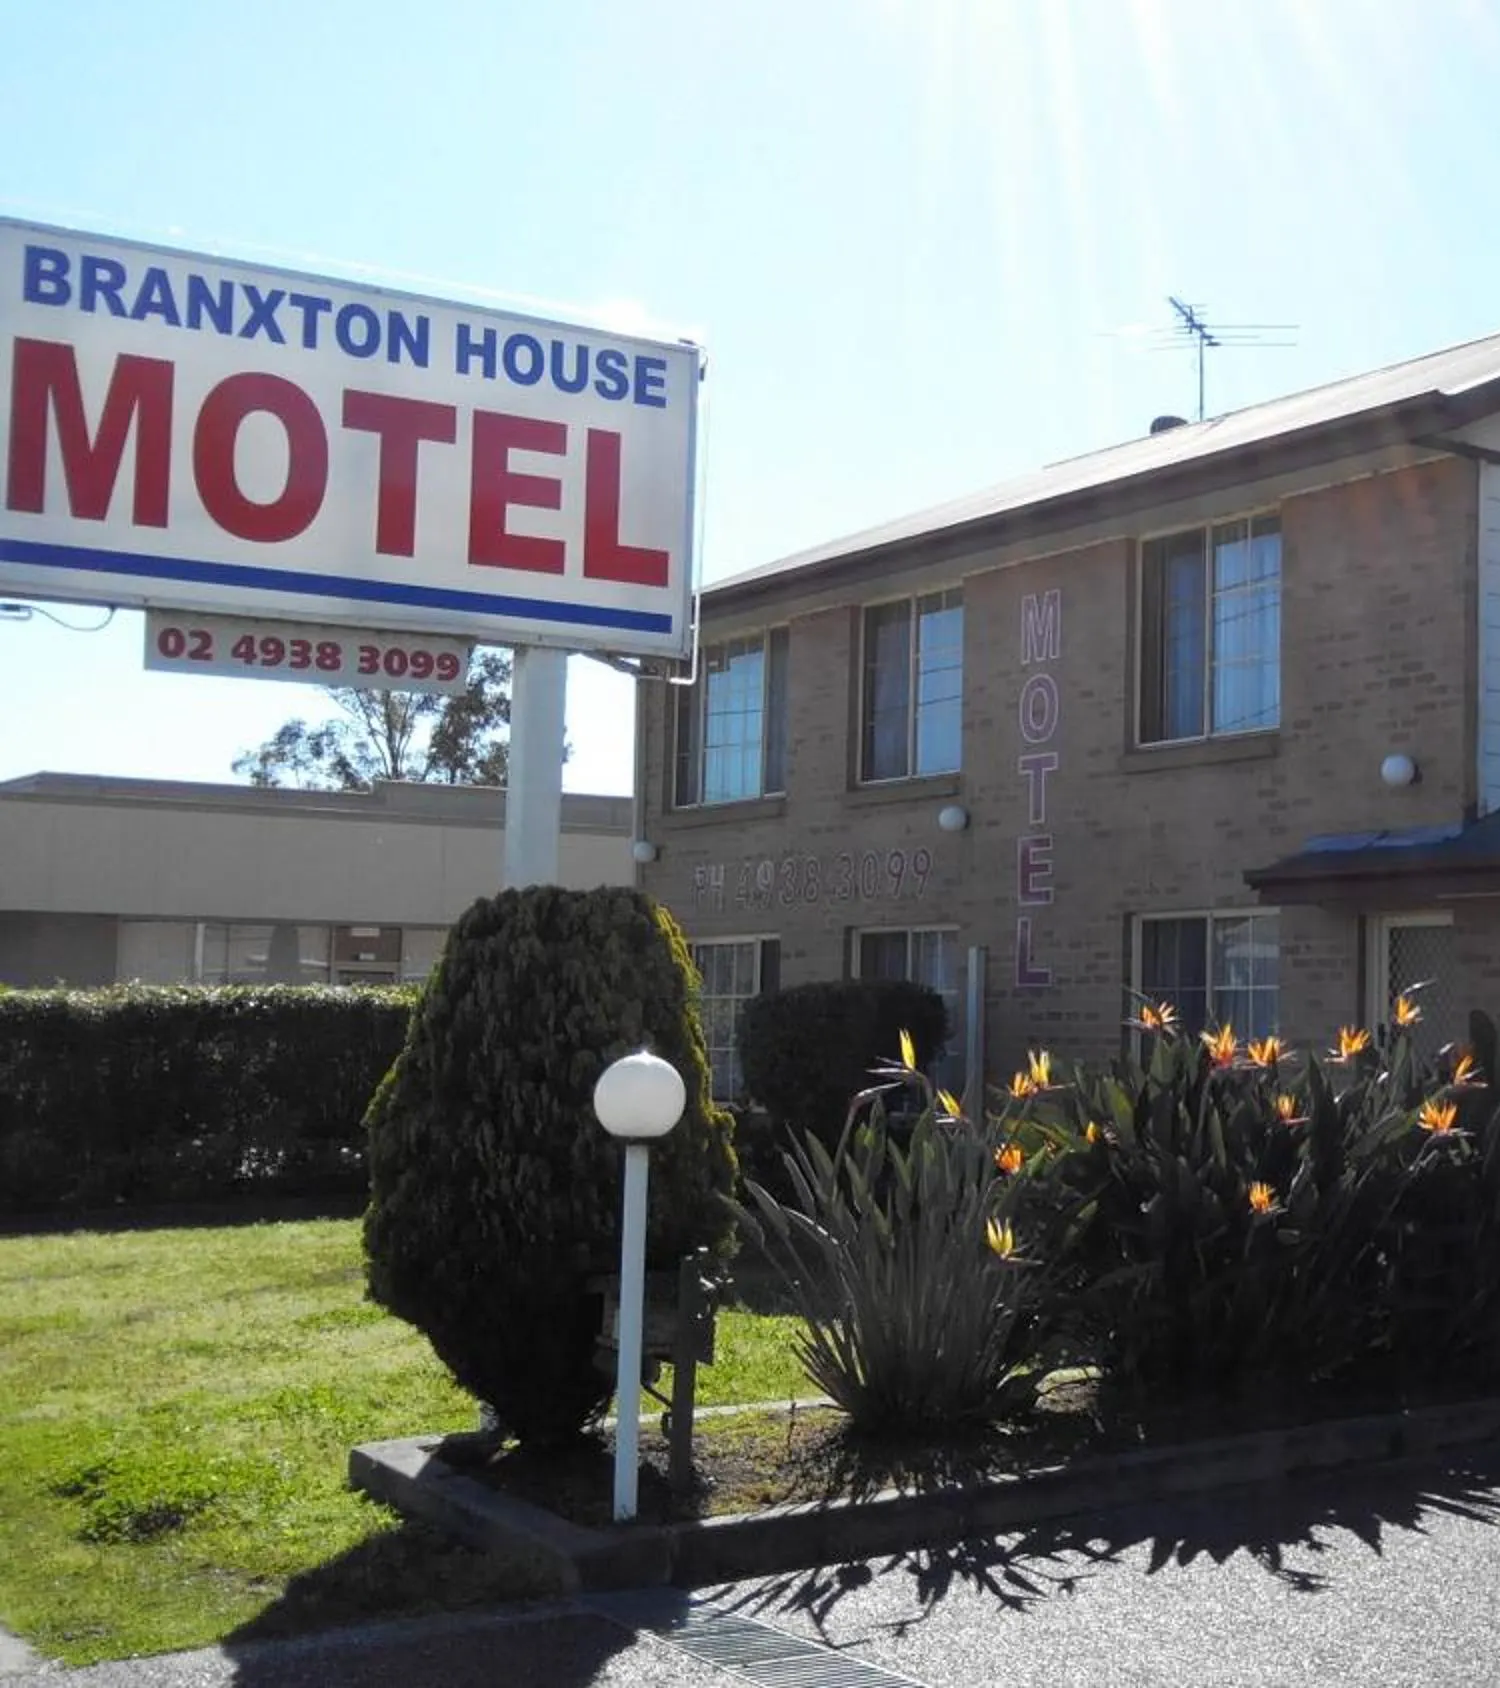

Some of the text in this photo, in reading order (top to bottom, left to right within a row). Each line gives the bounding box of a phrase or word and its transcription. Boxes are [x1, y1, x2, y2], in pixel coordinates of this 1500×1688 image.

[23, 244, 667, 408] BRANXTON HOUSE
[7, 336, 669, 588] MOTEL
[157, 626, 461, 682] 02 4938 3099
[1016, 589, 1062, 988] MOTEL
[734, 857, 822, 910] 4938
[830, 847, 933, 901] 3099
